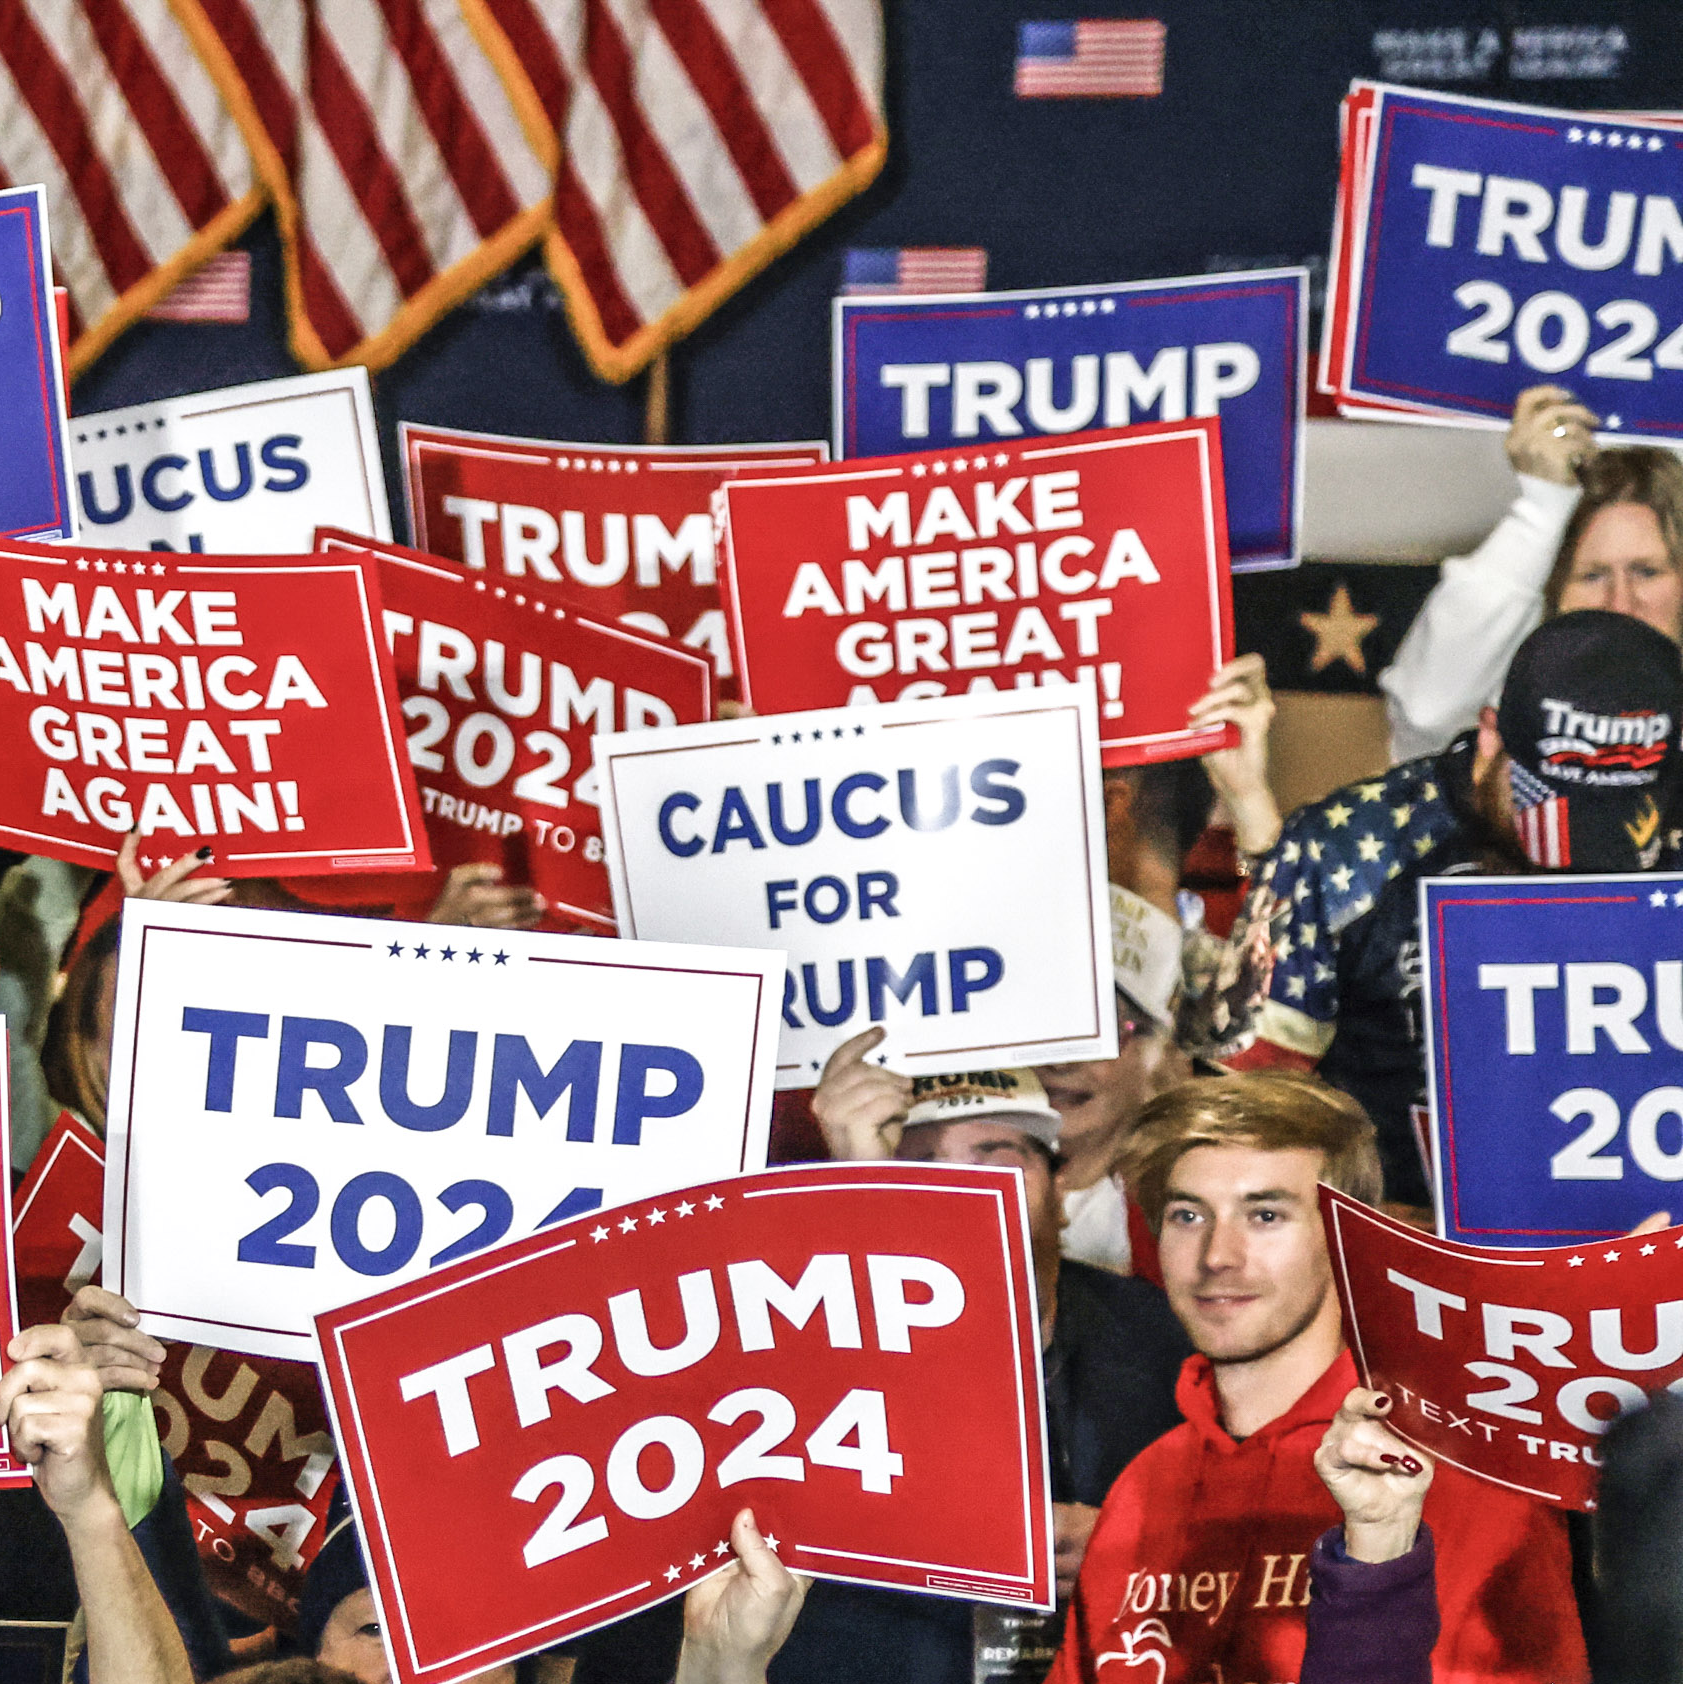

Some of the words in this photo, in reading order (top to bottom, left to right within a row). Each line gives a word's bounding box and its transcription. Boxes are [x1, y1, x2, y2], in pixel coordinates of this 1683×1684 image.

[1412, 163, 1683, 275] TRUM
[881, 342, 1261, 439] TRUMP
[78, 434, 311, 526] UCUS
[845, 469, 1083, 551] MAKE
[442, 494, 719, 588] TRUM
[783, 528, 1161, 618] AMERICA
[22, 578, 244, 646] MAKE
[836, 599, 1114, 678] GREAT
[29, 705, 282, 774] GREAT
[1539, 698, 1672, 748] Trump
[41, 769, 306, 835] AGAIN!
[423, 787, 524, 836] TRUMP
[535, 819, 576, 853] TO
[657, 758, 1027, 858] CAUCUS
[764, 869, 902, 930] FOR
[783, 945, 1006, 1030] RUMP
[181, 1006, 705, 1146] TRUMP
[1549, 1086, 1683, 1181] 20
[399, 1254, 967, 1459] TRUMP
[1387, 1268, 1683, 1370] TRU
[1396, 1383, 1500, 1442] TEXT
[1518, 1434, 1605, 1467] TRU
[1464, 1361, 1683, 1434] 20
[511, 1388, 905, 1570] 2024
